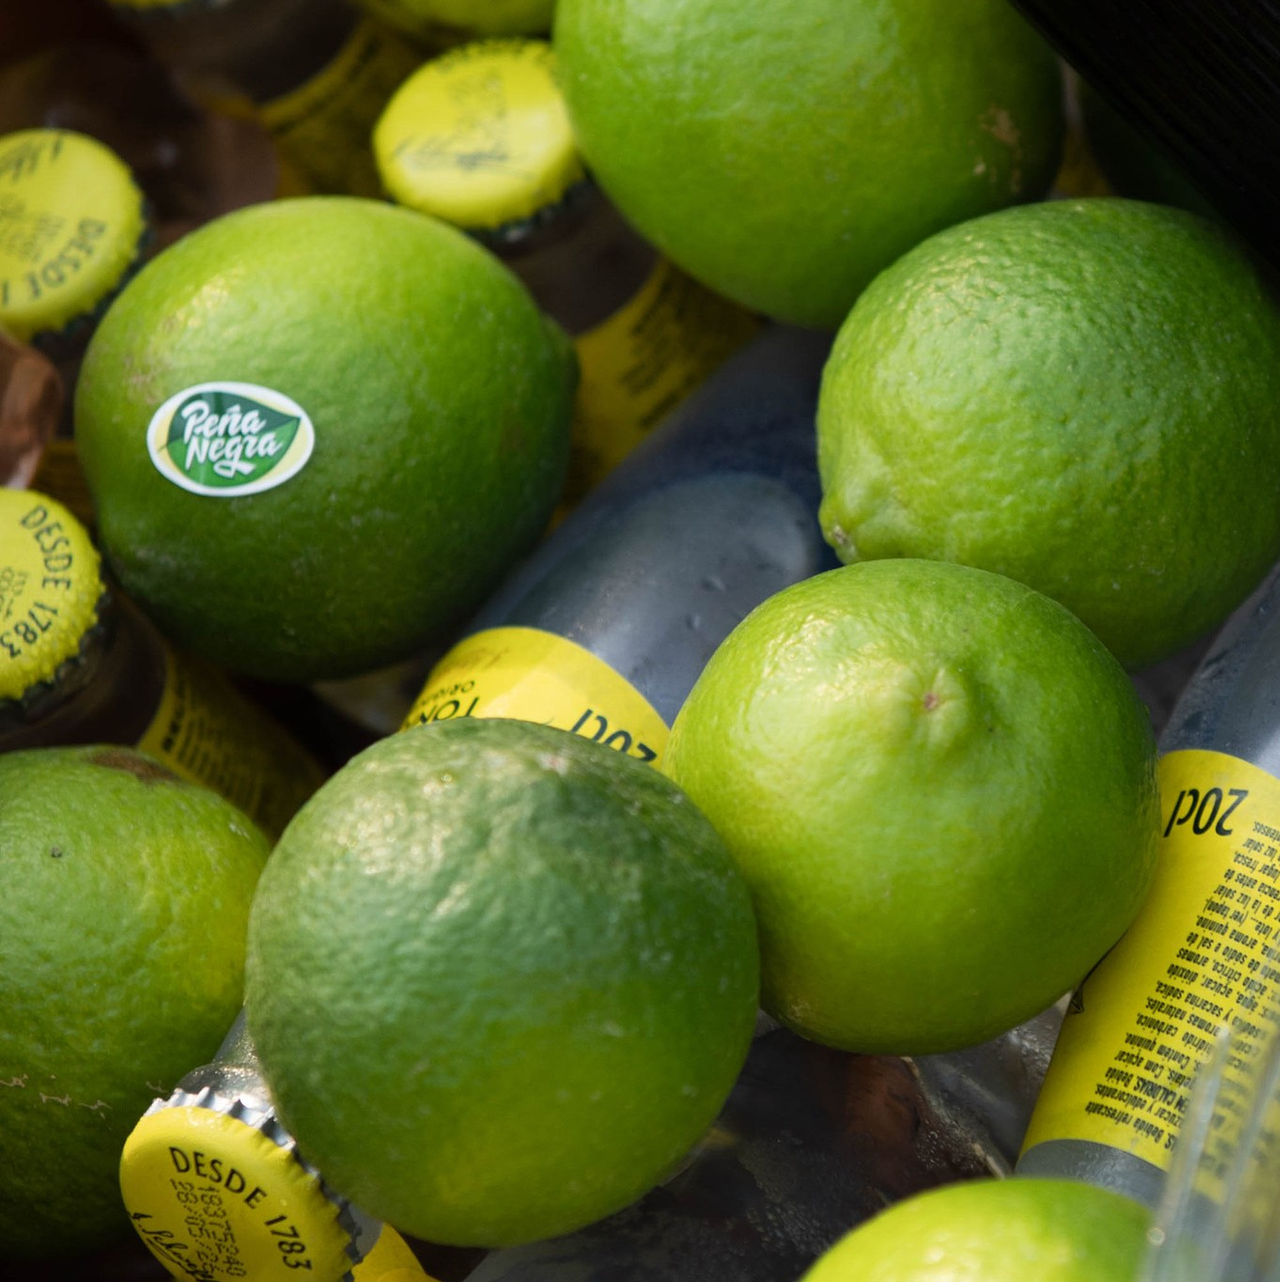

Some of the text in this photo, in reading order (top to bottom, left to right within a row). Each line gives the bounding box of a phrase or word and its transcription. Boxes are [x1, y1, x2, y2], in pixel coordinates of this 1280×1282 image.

[181, 400, 266, 444] Peña
[185, 433, 283, 478] Negra
[20, 505, 72, 590] DESDE
[0, 601, 58, 658] 1783
[1164, 788, 1249, 837] 20cl
[1242, 838, 1265, 853] solar
[1263, 847, 1278, 863] luz
[1233, 851, 1259, 874] fresco,
[1224, 869, 1236, 883] de
[1234, 873, 1258, 889] antes
[1202, 897, 1230, 919] tapón).
[1213, 884, 1274, 919] de la luz solar
[1229, 910, 1249, 927] (ver
[1196, 915, 1258, 950] aroma quinino.
[1176, 947, 1210, 967] aromas
[1186, 932, 1261, 974] de sódio e sal de
[1166, 963, 1199, 985] dióxido
[1212, 959, 1242, 984] cítrico,
[1155, 980, 1185, 1000] sódica,
[1200, 974, 1234, 999] açúcar,
[1145, 996, 1187, 1021] naturales,
[1184, 992, 1224, 1018] sacarina
[1136, 1012, 1178, 1037] carbónico,
[1114, 1050, 1144, 1067] açúcar
[1124, 1032, 1191, 1071] Contém quinino.
[1144, 1060, 1165, 1079] Com
[1133, 1077, 1177, 1106] CALORIAS.
[1084, 1101, 1165, 1143] Bebida refrescante
[169, 1147, 312, 1271] DESDE 1783
